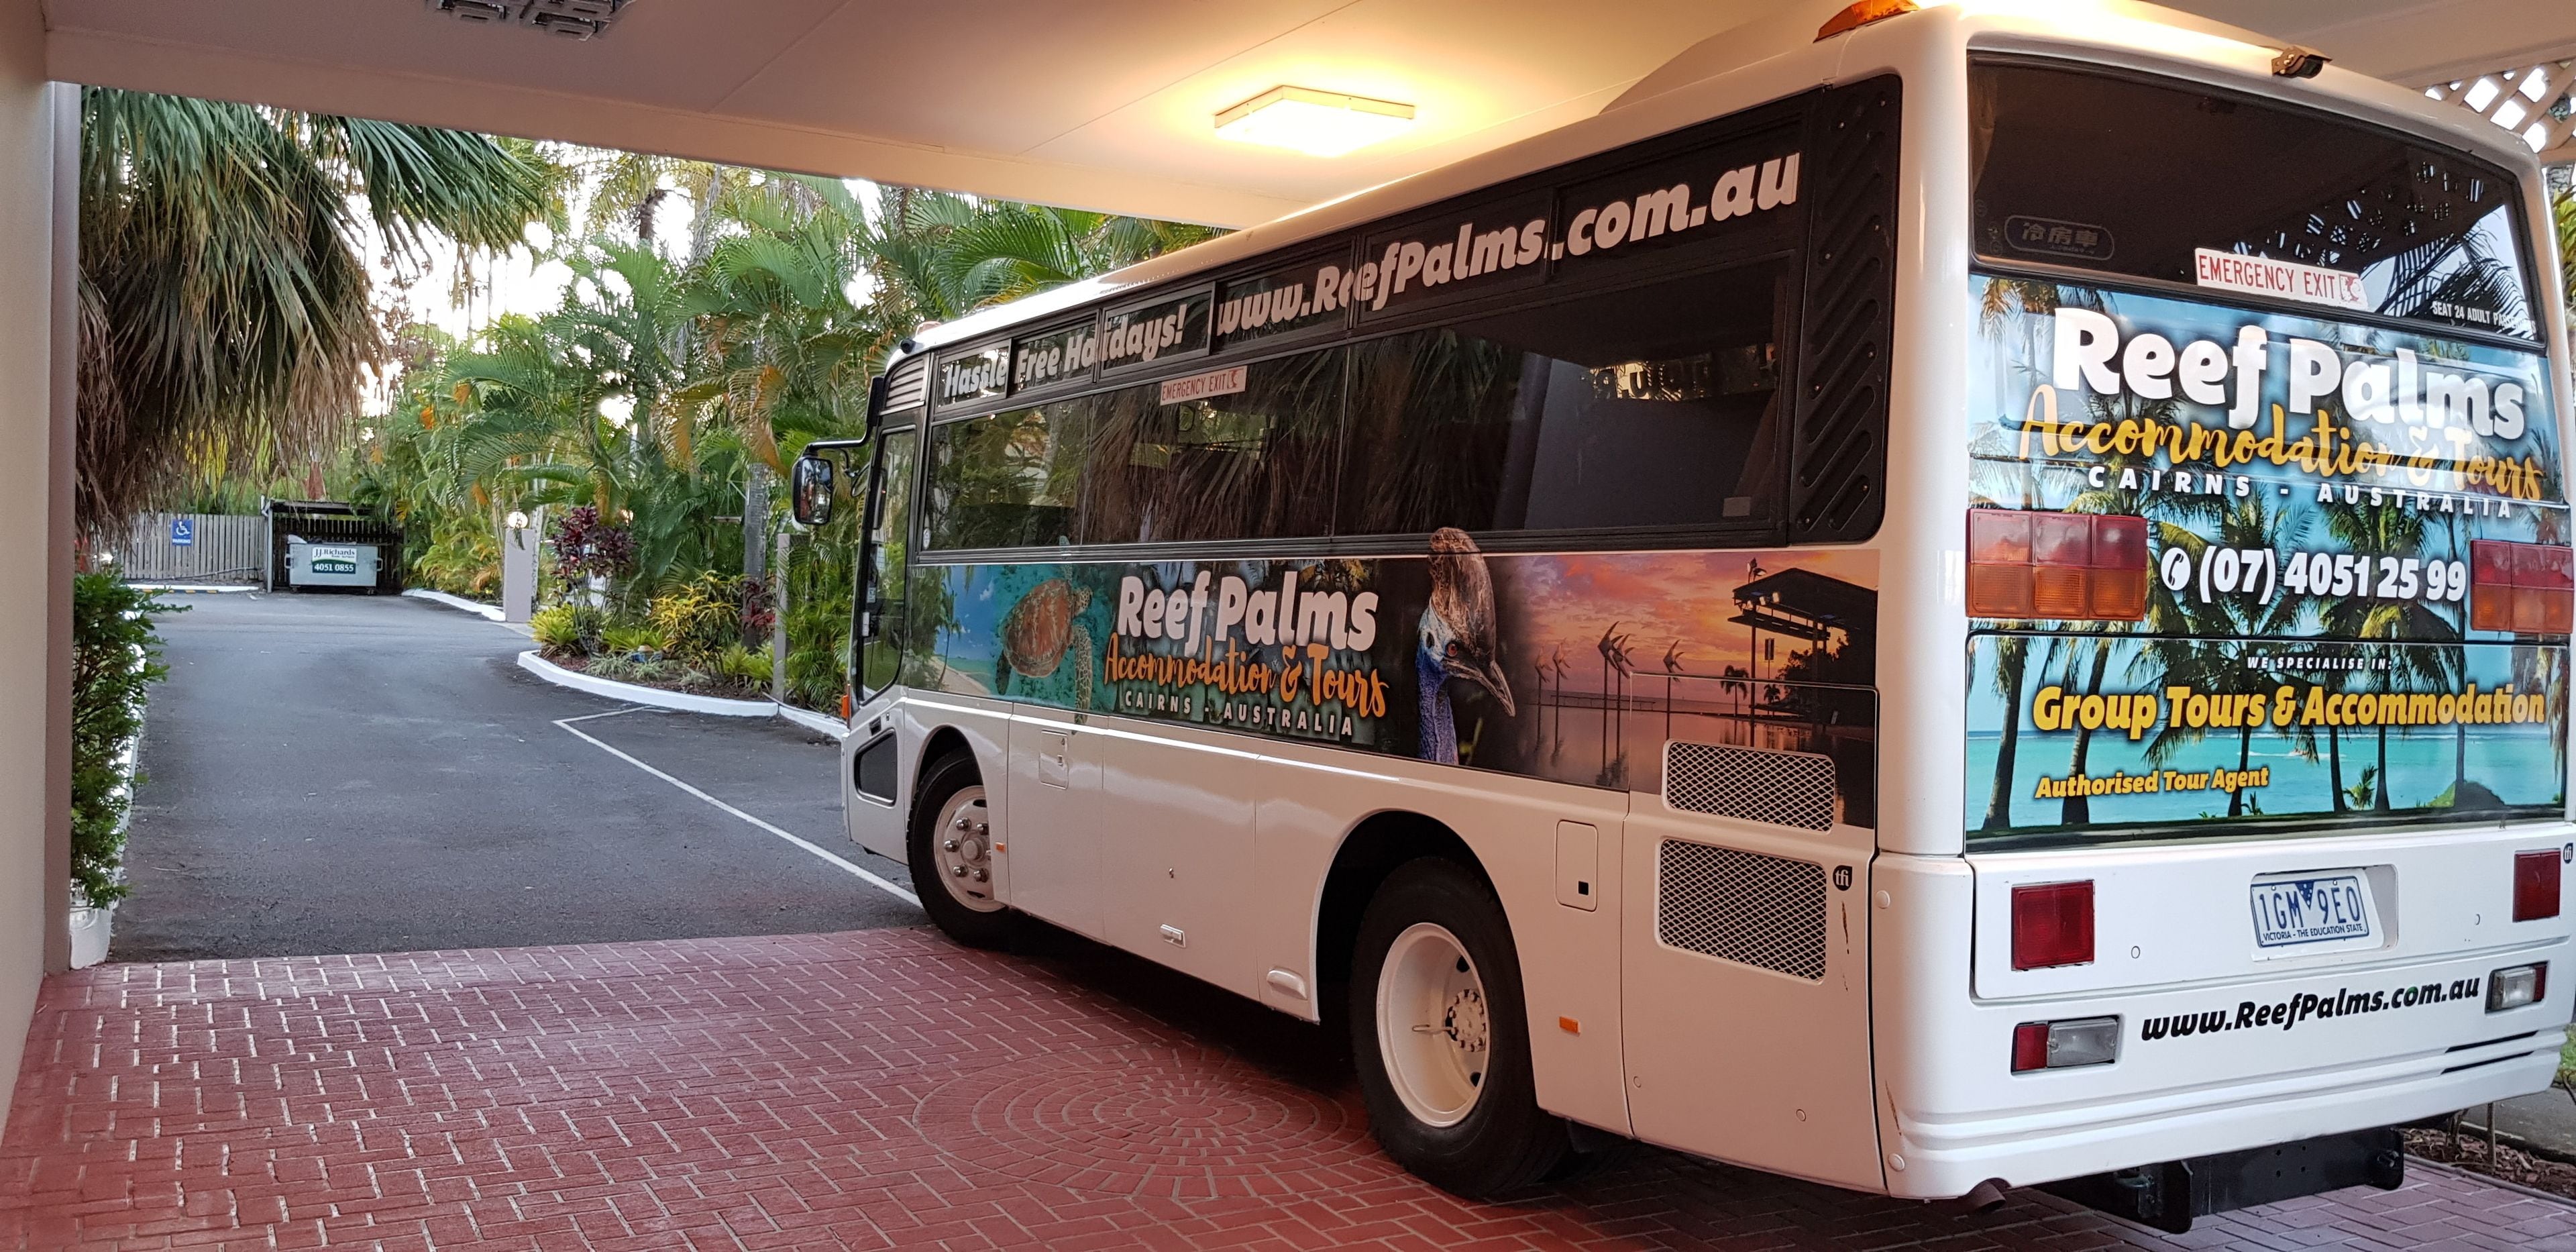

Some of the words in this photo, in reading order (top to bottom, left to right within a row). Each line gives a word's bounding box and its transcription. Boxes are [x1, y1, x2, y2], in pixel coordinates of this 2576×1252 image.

[1217, 152, 1801, 336] www.ReefPalms.com.au
[2198, 254, 2294, 293] EMERGENCY
[2303, 270, 2335, 299] EXIT
[2432, 301, 2453, 318] SEAT
[2455, 305, 2465, 320] 24
[2467, 307, 2491, 324] ADULT
[944, 358, 1007, 398] Hassle
[1014, 347, 1061, 384] Free
[1063, 304, 1187, 372] Holidays!
[2053, 307, 2268, 431] Reef
[2289, 338, 2526, 440] Palms
[1161, 377, 1207, 401] EMERGENCY
[1210, 373, 1227, 393] EXIT
[2019, 383, 2403, 478] Accommodation
[2443, 425, 2544, 501] Tours
[2088, 465, 2252, 498] CAIRNS
[2317, 483, 2513, 519] AUSTRALIA
[314, 563, 333, 572] 4051
[334, 564, 354, 572] 0855
[2199, 544, 2277, 606] (07)
[2284, 552, 2374, 597] 4051
[2376, 557, 2419, 601] 25
[2425, 560, 2467, 602] 99
[1117, 570, 1212, 658] Reef
[1215, 570, 1379, 652] Palms
[1104, 632, 1277, 695] Accommodation
[1279, 643, 1303, 703] &
[1306, 642, 1390, 719] Tours
[2247, 656, 2269, 669] WE
[2276, 657, 2365, 670] SPECIALISE
[2370, 658, 2393, 670] IN:
[1124, 690, 1192, 715] CAIRNS
[1223, 702, 1354, 737] AUSTRALIA
[2032, 685, 2158, 741] Group
[2166, 683, 2267, 729] Tours
[2271, 683, 2298, 728] &
[2300, 681, 2546, 728] Accommodation
[2035, 772, 2161, 800] Authorised
[2163, 770, 2209, 794] Tour
[2211, 766, 2270, 796] Agent
[1835, 869, 1850, 887] tfi
[2259, 890, 2304, 931] 1GM
[2263, 932, 2292, 941] VICTORIA
[2297, 929, 2309, 938] THE
[2310, 925, 2346, 937] EDUCATION
[2346, 923, 2363, 933] STATE
[2141, 976, 2481, 1042] www.ReefPalms.com.au
